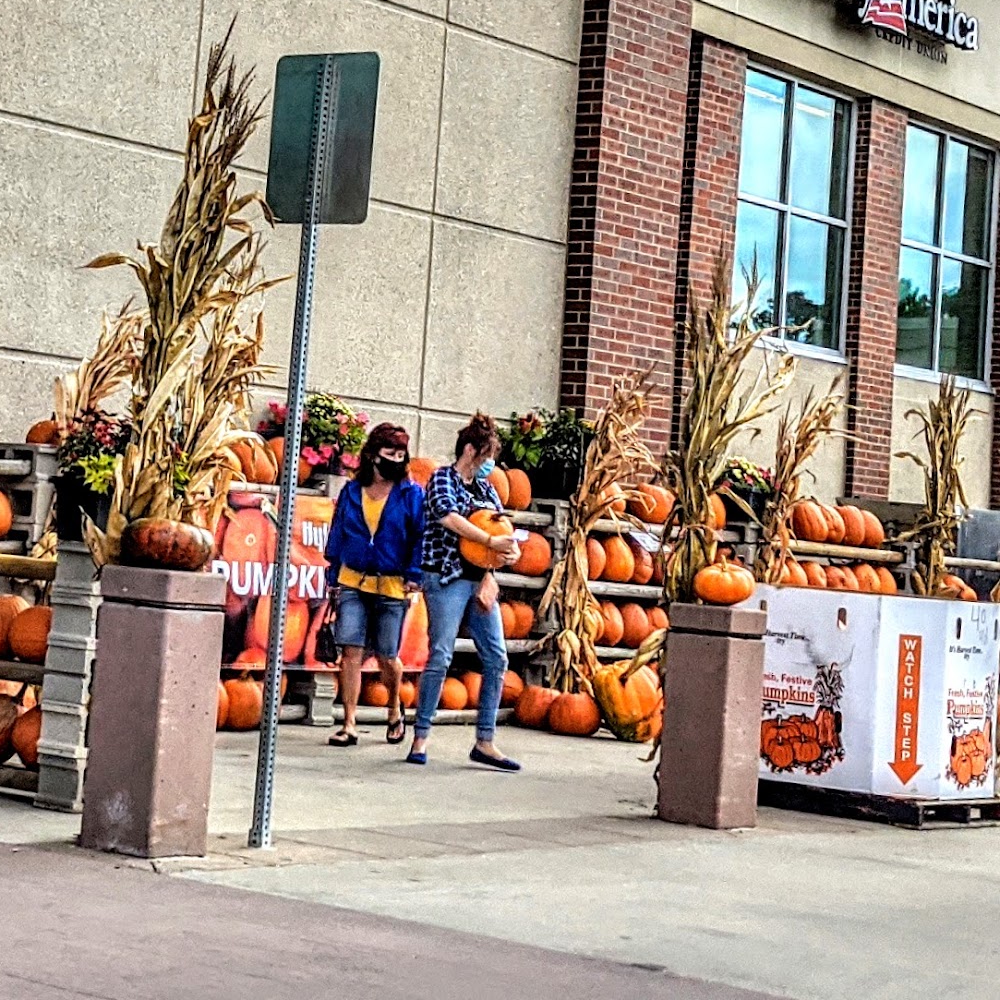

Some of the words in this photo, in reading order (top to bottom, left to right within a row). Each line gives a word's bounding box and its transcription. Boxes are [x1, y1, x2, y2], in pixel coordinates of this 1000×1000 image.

[903, 639, 917, 699] WATCH
[781, 673, 813, 685] Festive
[762, 686, 816, 704] umpkins
[946, 699, 985, 716] Pumpkins
[901, 712, 912, 761] STEP
